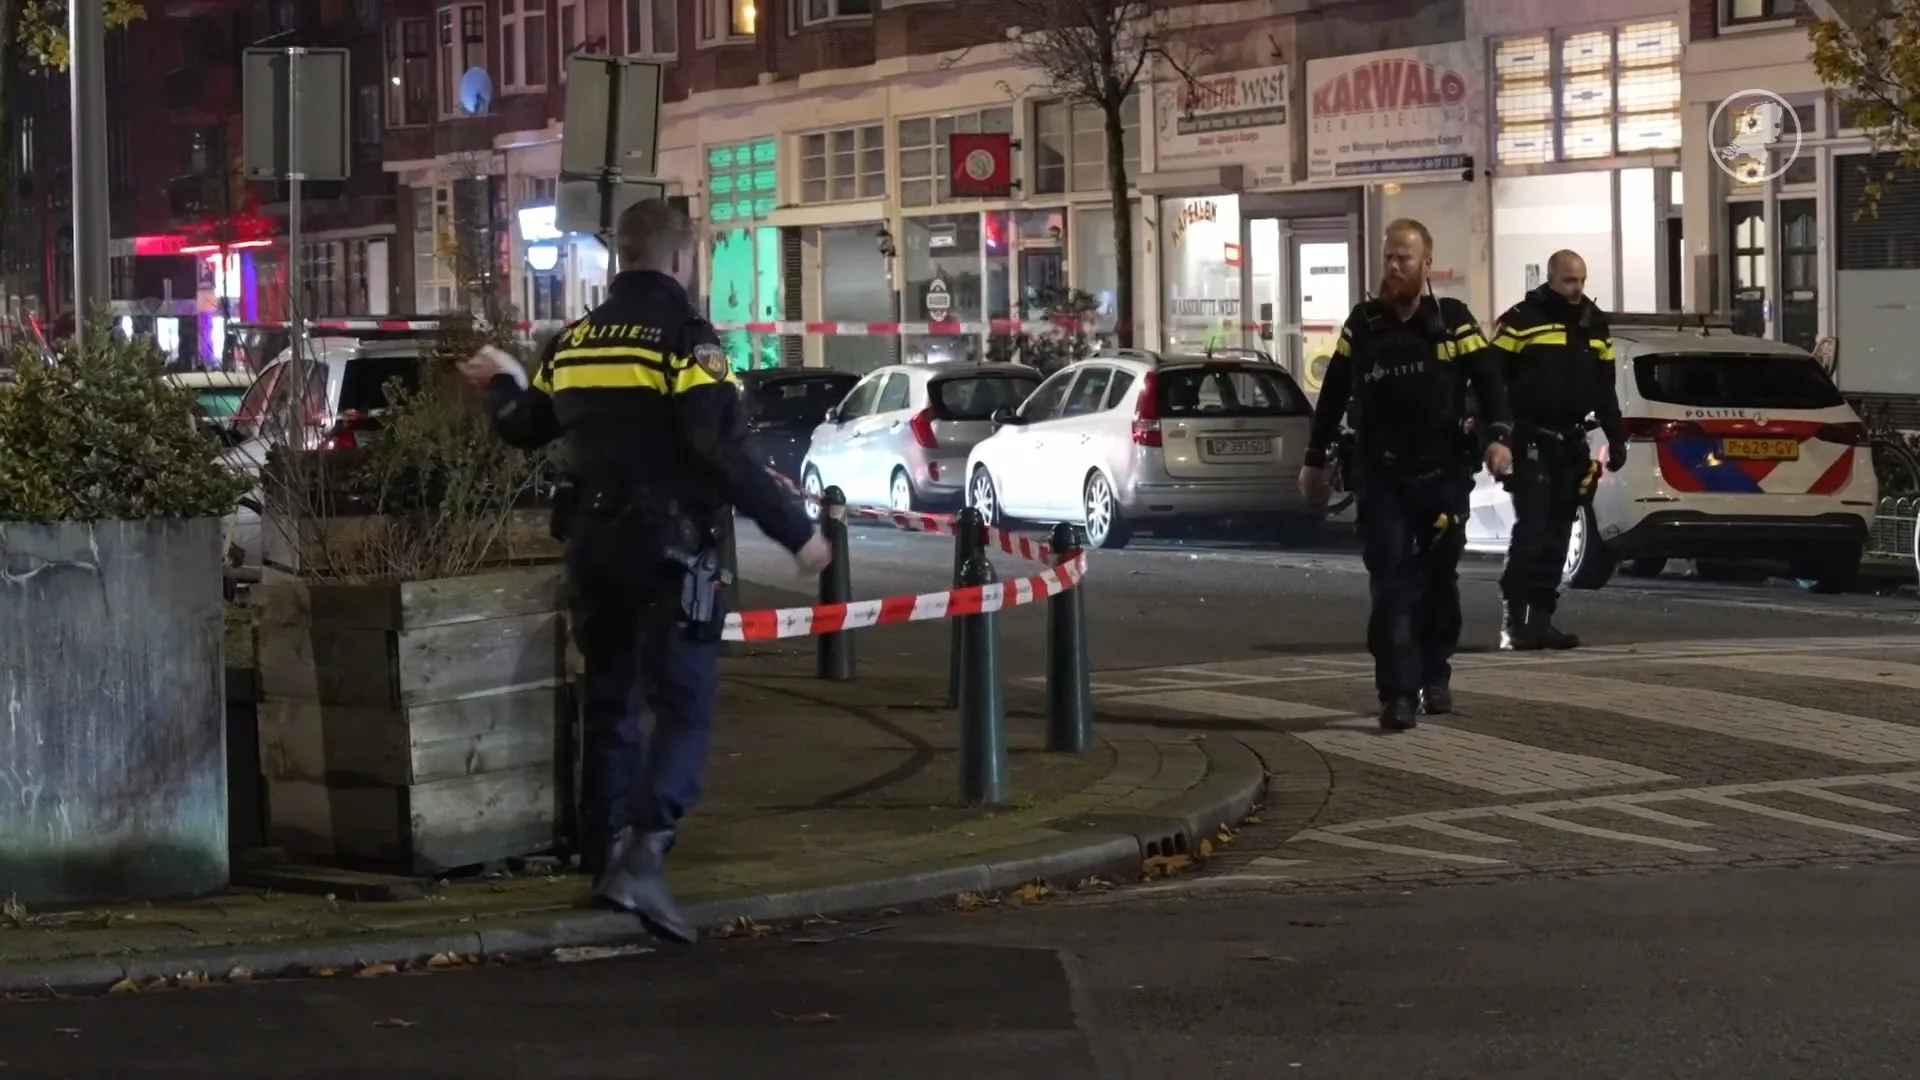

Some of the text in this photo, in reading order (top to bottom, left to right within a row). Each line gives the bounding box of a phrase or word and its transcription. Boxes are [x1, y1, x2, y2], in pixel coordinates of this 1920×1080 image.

[1313, 58, 1466, 118] KARWALO
[560, 318, 643, 347] POLITIE
[1363, 361, 1425, 383] POLITIE
[1685, 409, 1746, 418] POLITIE
[1728, 441, 1794, 455] P-629-GV
